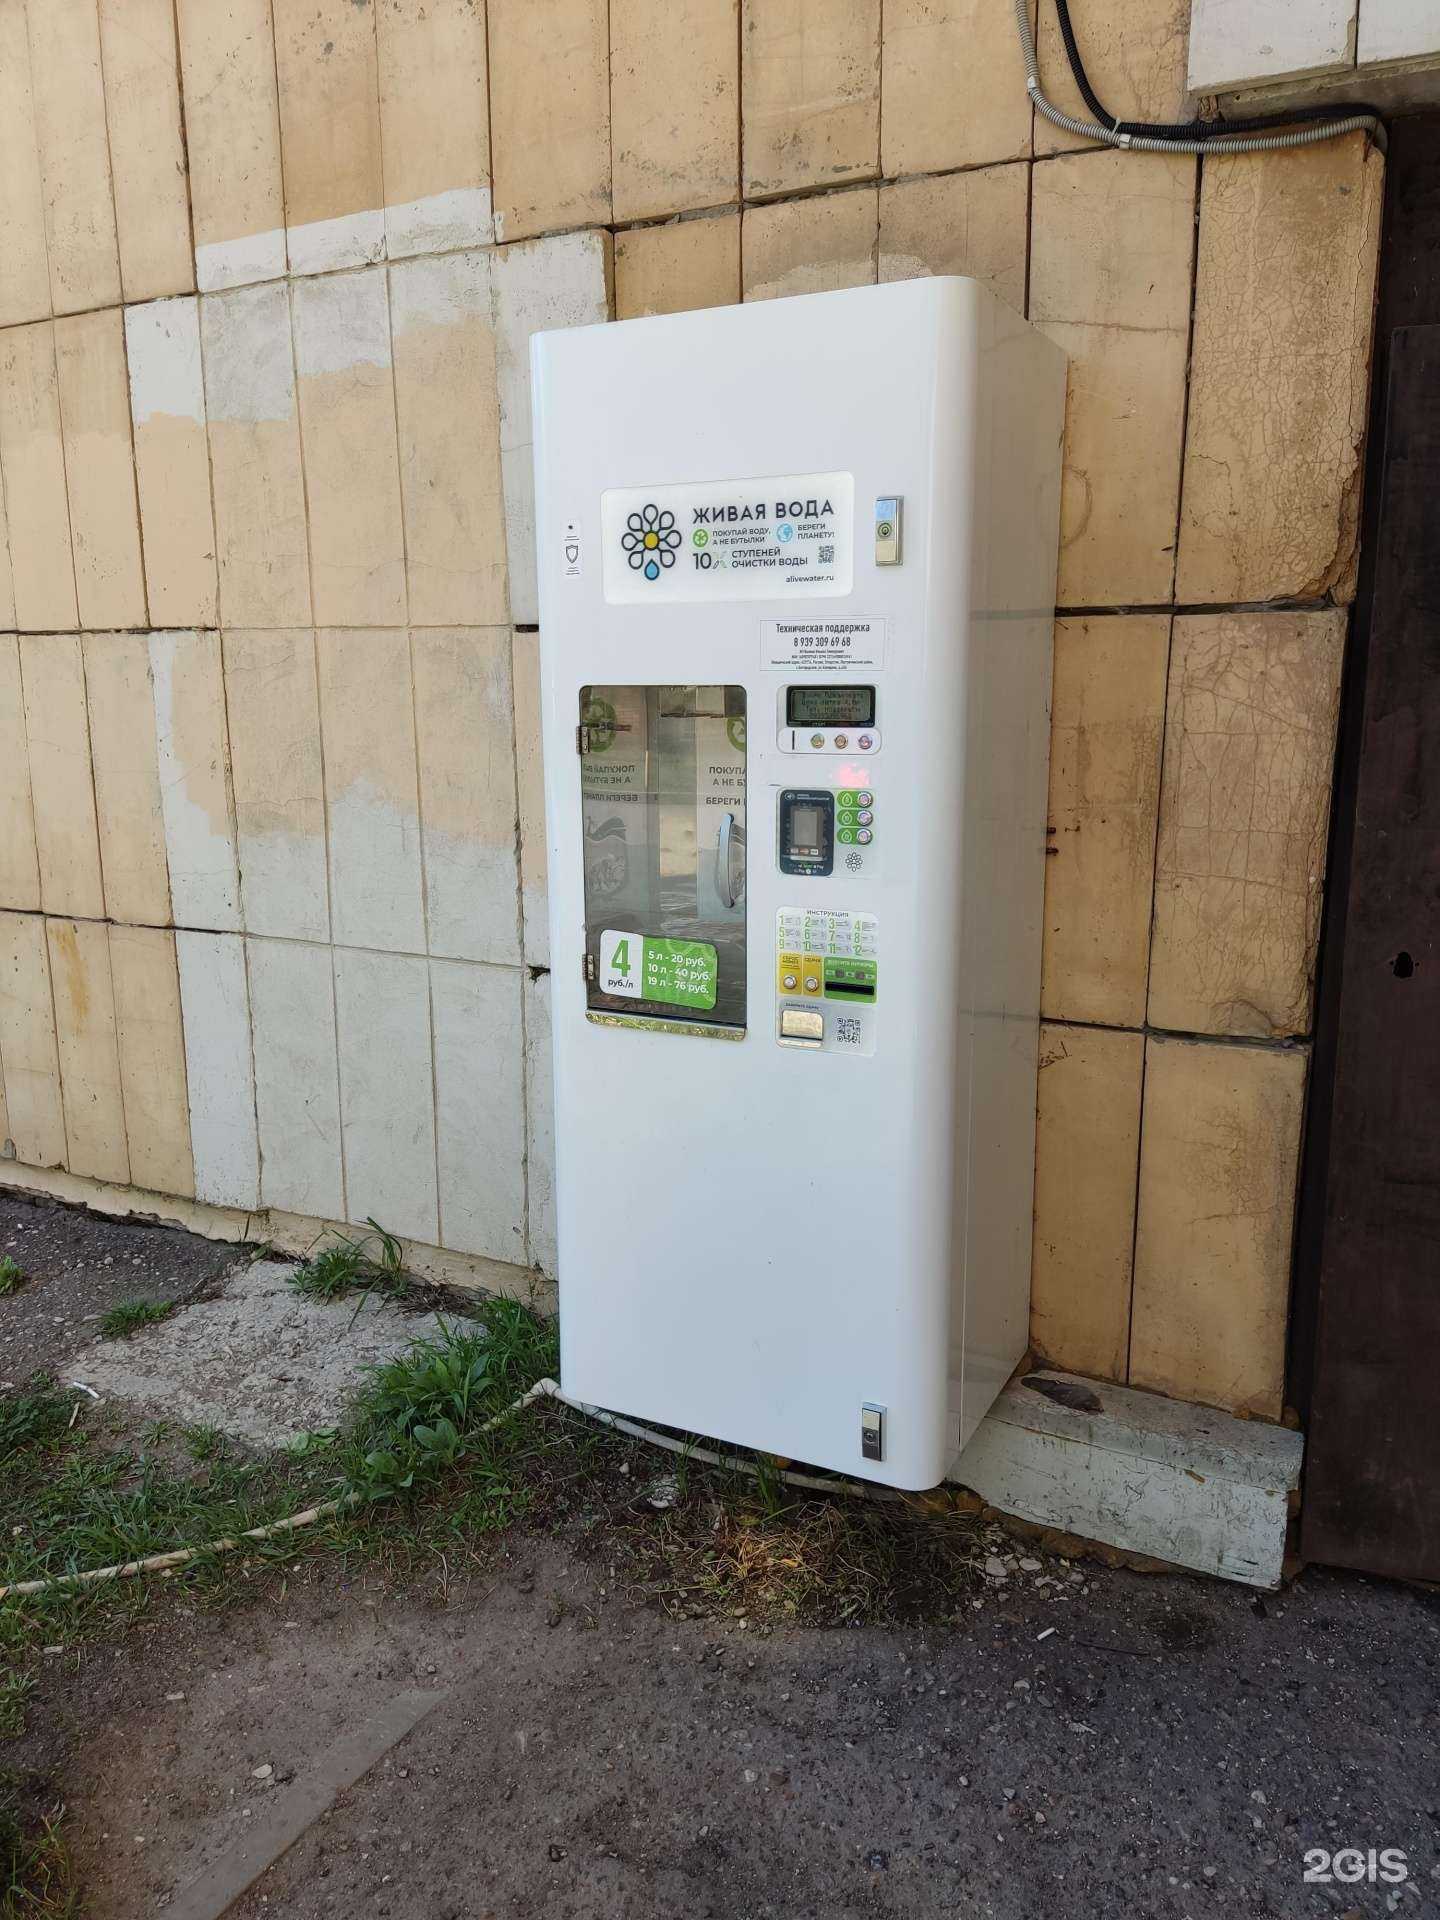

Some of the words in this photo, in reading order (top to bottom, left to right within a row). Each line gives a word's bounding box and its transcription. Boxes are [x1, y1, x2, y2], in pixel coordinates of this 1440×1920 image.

[693, 504, 766, 525] ЖИВАЯ
[775, 499, 834, 520] ВОДА
[712, 528, 748, 538] ПОКУПАЙ
[749, 527, 771, 537] ВОДУ,
[797, 523, 826, 531] БЕРЕГИ
[719, 537, 729, 545] НЕ
[729, 536, 765, 544] БУТЫЛКИ
[797, 531, 835, 540] ПЛАНЕТУ!
[731, 547, 781, 558] СТУПЕНЕЙ
[693, 552, 711, 570] 10
[731, 558, 777, 568] ОЧИСТКИ
[778, 556, 808, 567] ВОДЫ
[785, 575, 834, 584] alivewater.ru
[776, 623, 823, 633] Техническая
[825, 623, 870, 634] поддержка
[794, 637, 798, 647] 8
[800, 637, 813, 647] 939
[815, 637, 829, 647] 309
[831, 637, 839, 647] 69
[841, 637, 851, 647] 68
[713, 778, 720, 786] А
[722, 778, 735, 786] НЕ
[706, 796, 741, 806] БЕРЕГИ
[807, 910, 849, 918] ИНСТРУКЦИЯ
[611, 939, 631, 977] 4
[648, 950, 655, 959] 5
[671, 954, 684, 964] 20
[686, 956, 706, 967] руб.
[648, 963, 658, 972] 10
[675, 968, 688, 977] 40
[690, 969, 711, 981] руб.
[608, 978, 634, 989] руб./л
[648, 976, 657, 985] 19
[675, 981, 686, 990] 76
[688, 983, 709, 994] руб.
